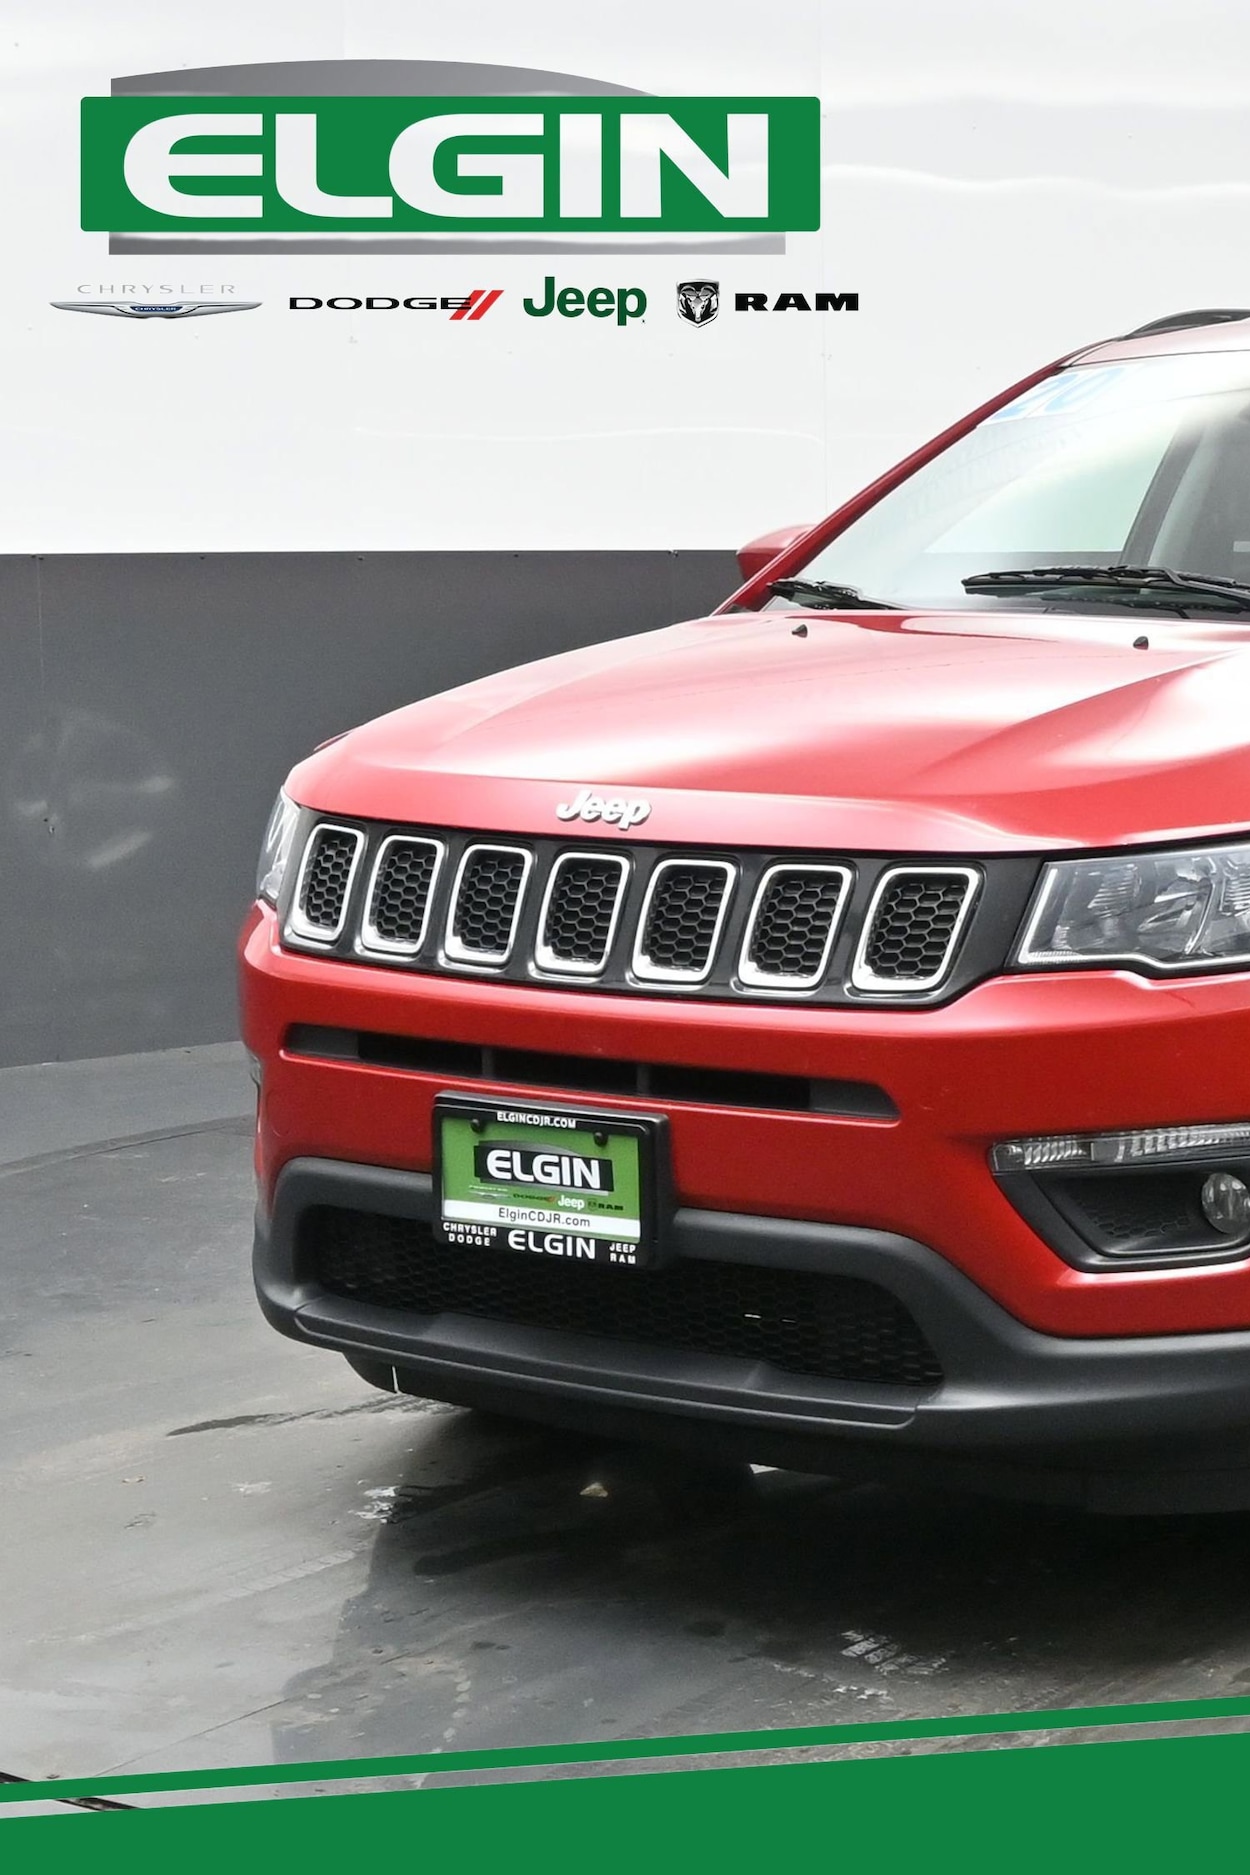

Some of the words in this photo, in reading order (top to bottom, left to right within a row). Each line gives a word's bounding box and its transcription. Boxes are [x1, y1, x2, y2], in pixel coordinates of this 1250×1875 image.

[555, 789, 652, 831] Jeep
[497, 1111, 576, 1129] ELGINCDJR.COM
[486, 1150, 600, 1189] ELGIN
[557, 1194, 585, 1210] Jeep
[498, 1207, 591, 1227] ElginCDJR.com
[443, 1222, 497, 1237] CHRYSLER
[448, 1234, 490, 1246] DODGE
[508, 1230, 596, 1259] ELGIN
[609, 1242, 636, 1253] JEEP
[610, 1253, 636, 1265] RAM
